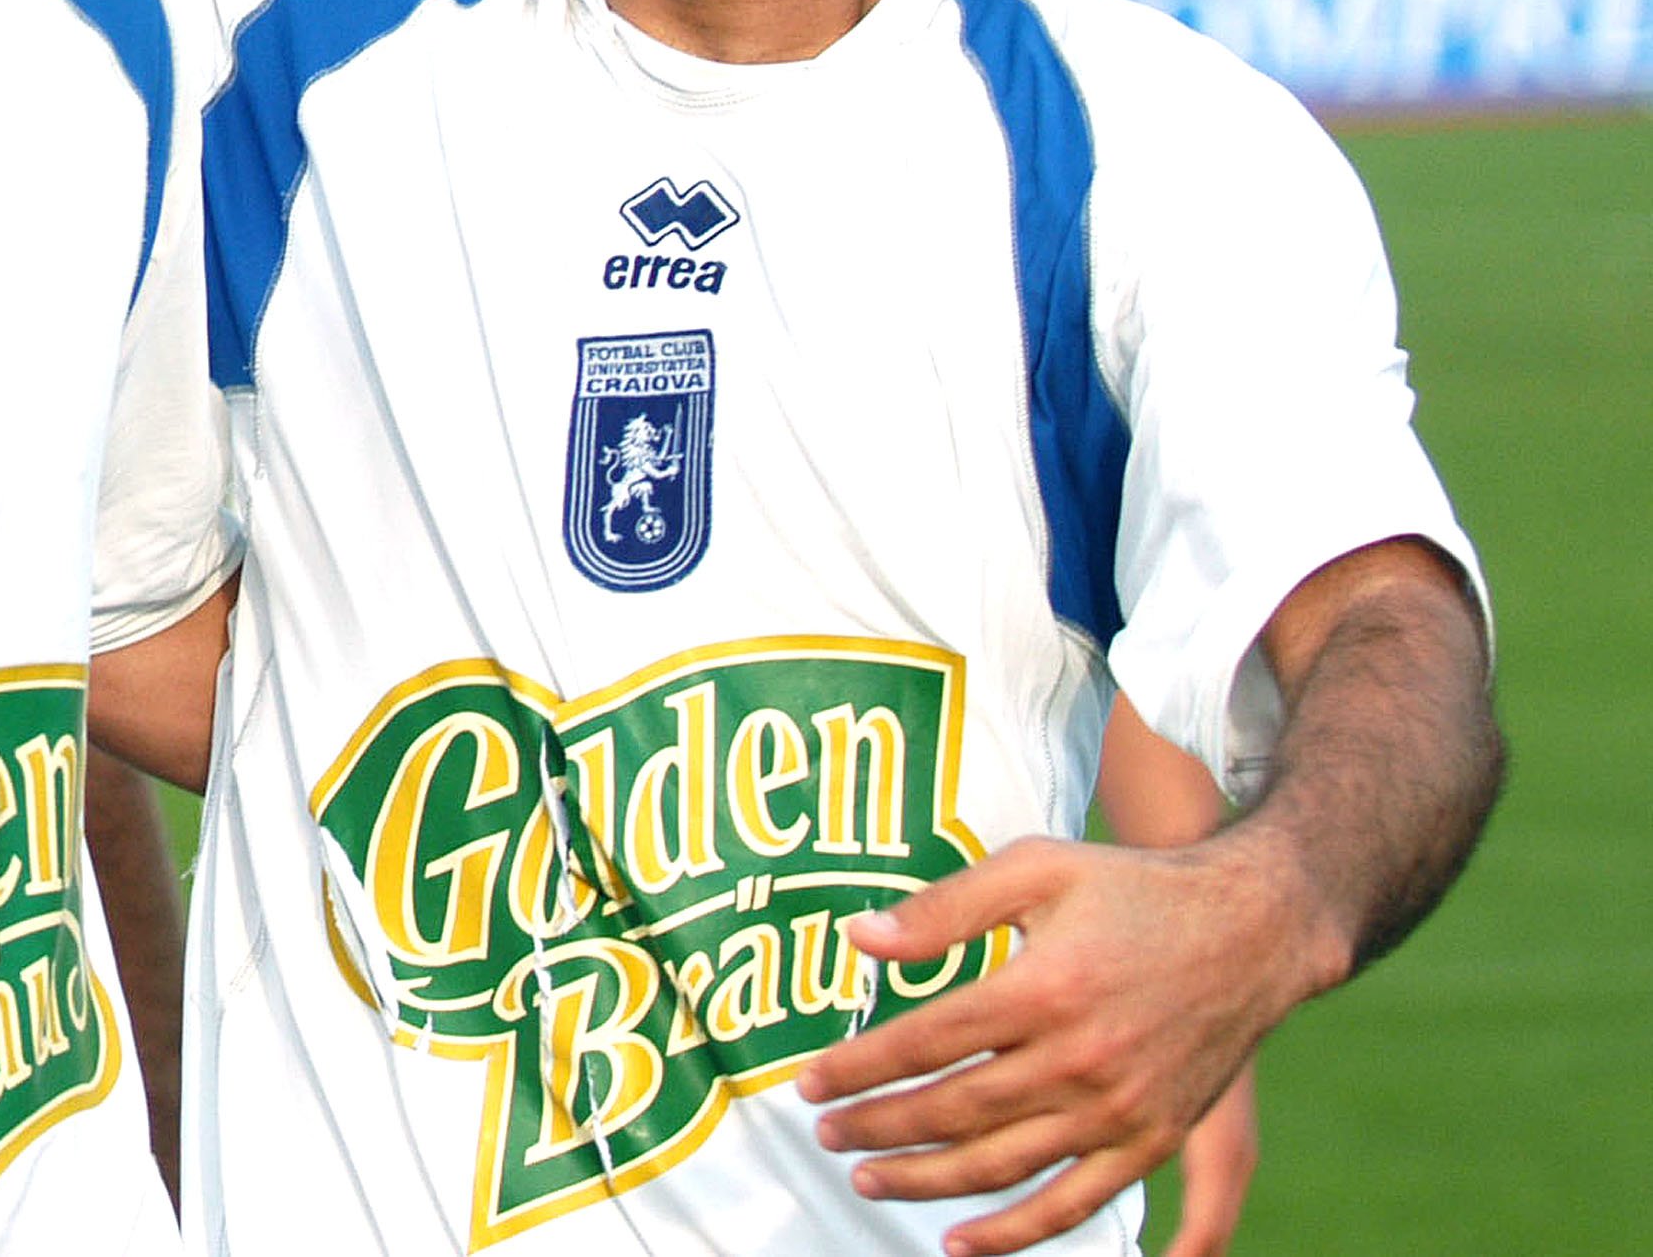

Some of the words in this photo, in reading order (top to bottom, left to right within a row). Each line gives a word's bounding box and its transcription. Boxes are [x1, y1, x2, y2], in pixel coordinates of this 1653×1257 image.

[586, 344, 655, 361] FOTBAL
[661, 340, 706, 357] CLUB
[587, 357, 706, 376] UNIVERSITATEA
[586, 373, 704, 394] CRAIOVA
